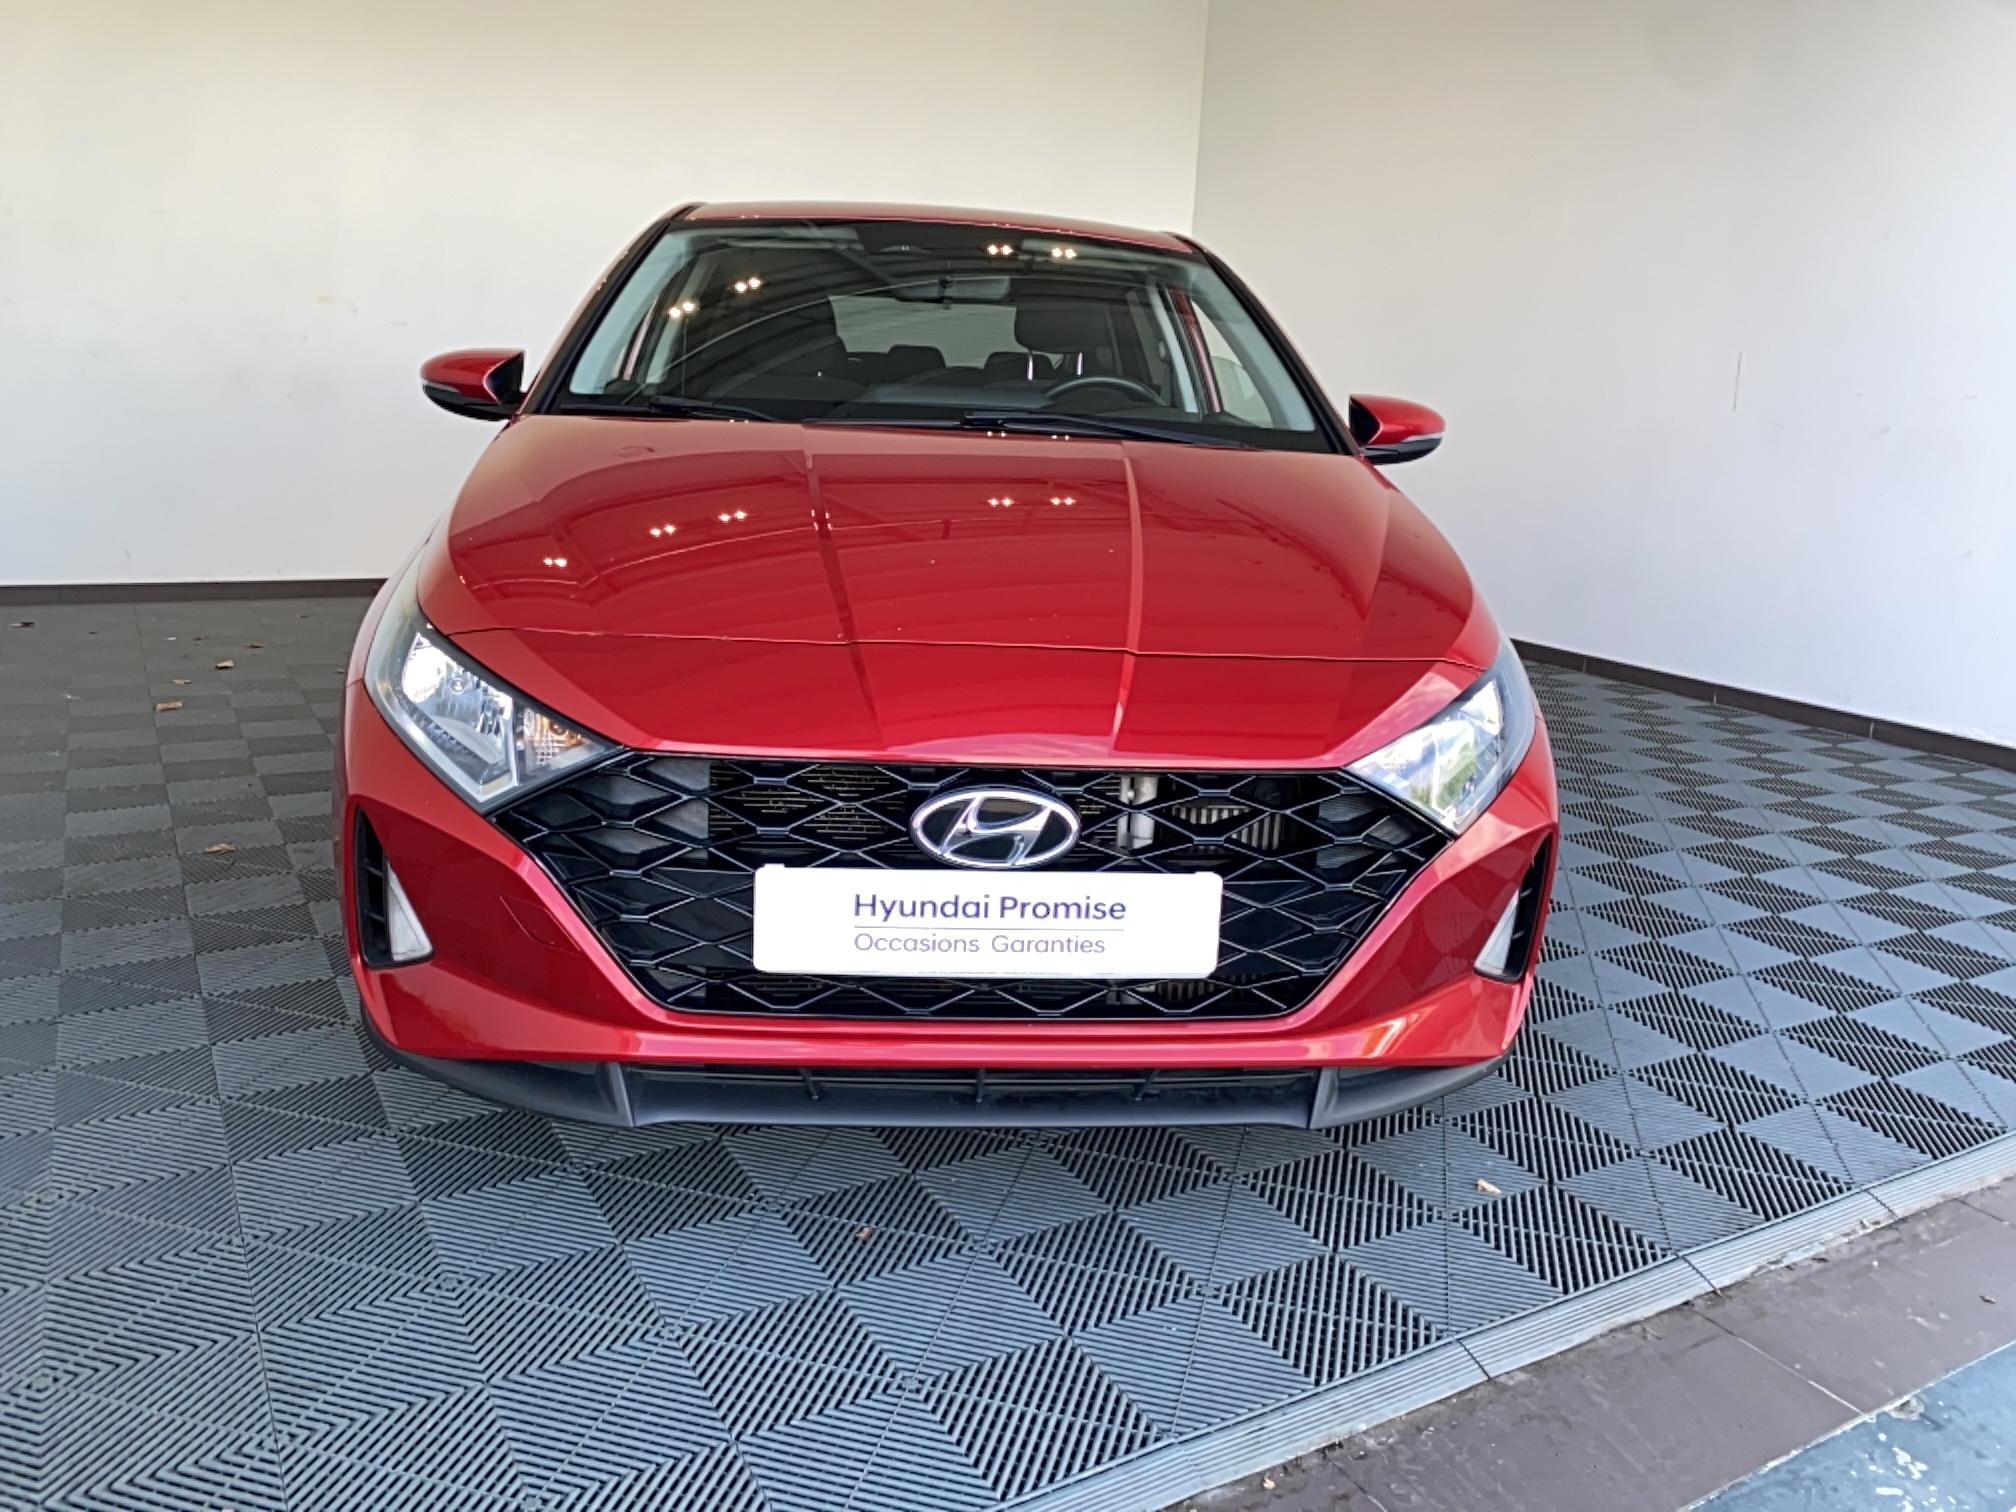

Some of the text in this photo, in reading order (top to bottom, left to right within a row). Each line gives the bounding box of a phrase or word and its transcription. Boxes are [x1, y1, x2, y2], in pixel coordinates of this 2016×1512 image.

[854, 893, 1127, 922] Hyundai Promise
[853, 932, 1106, 954] Occasions Garanties
